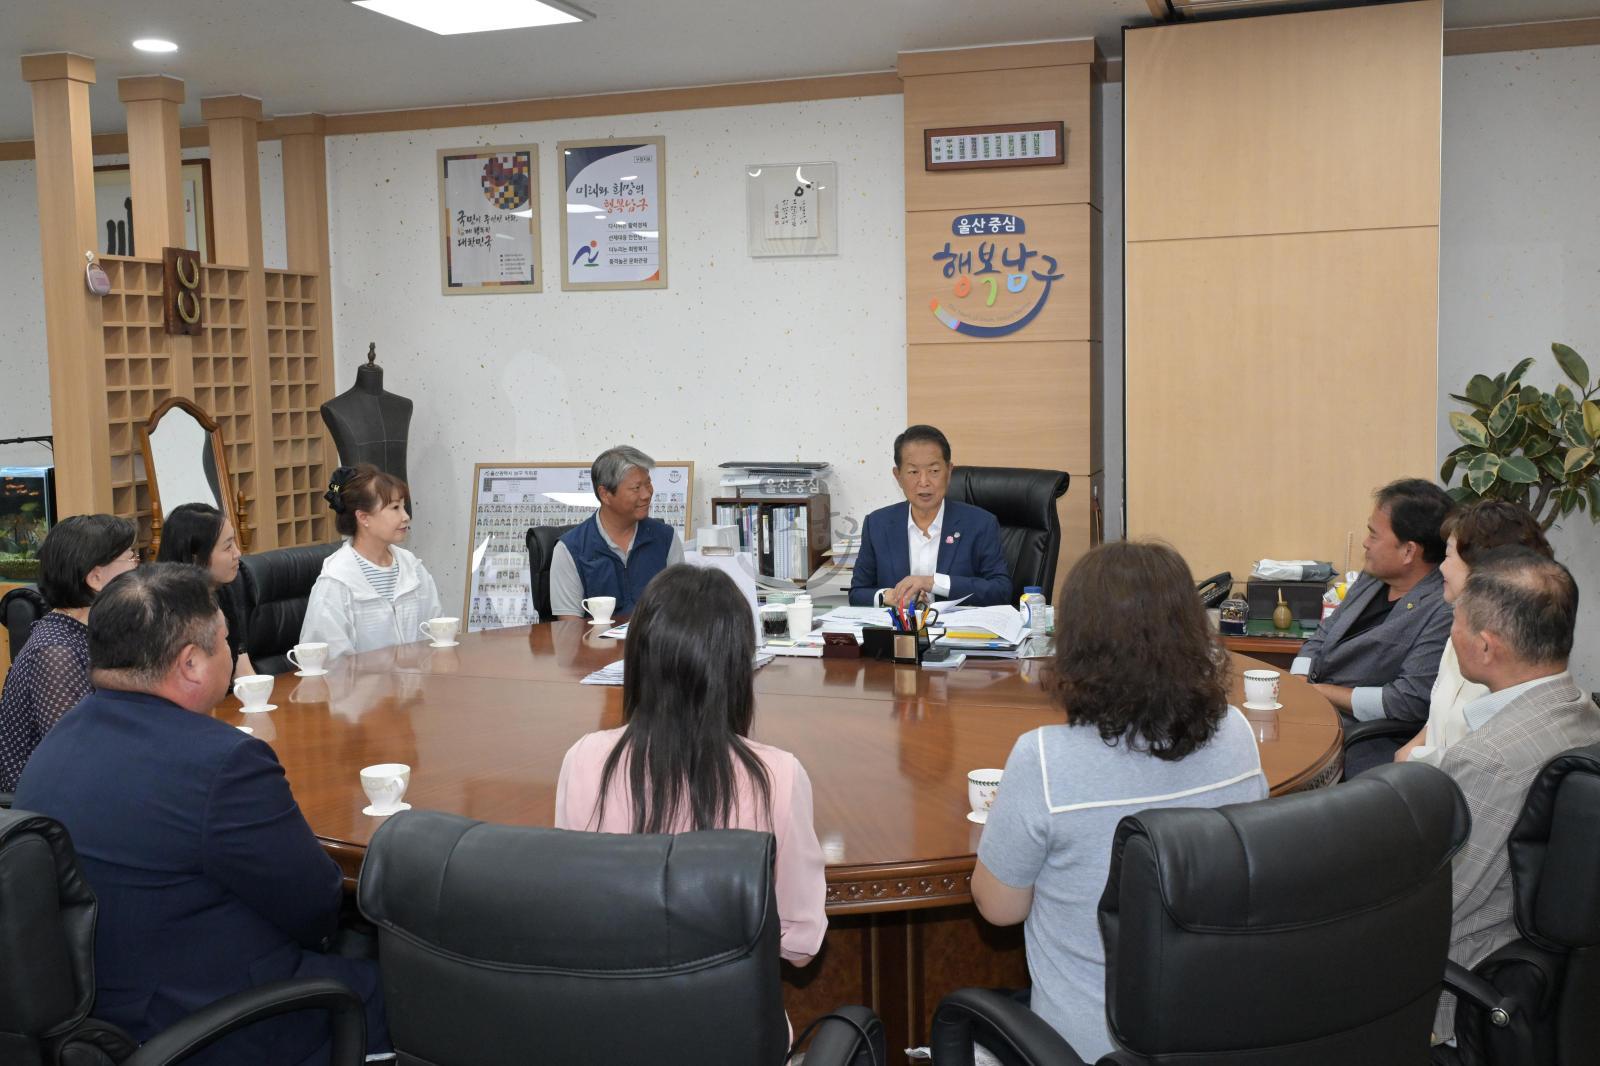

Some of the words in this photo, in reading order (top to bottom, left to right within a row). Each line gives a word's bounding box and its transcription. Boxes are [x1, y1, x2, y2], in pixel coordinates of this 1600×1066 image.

[576, 183, 609, 198] 미래와
[612, 182, 644, 196] 희망의
[604, 198, 648, 213] 행복남구
[457, 210, 481, 227] 국민이
[957, 217, 986, 234] 울산
[988, 216, 1016, 233] 중심
[457, 235, 493, 253] 대한민국
[932, 241, 1065, 306] 행복남구
